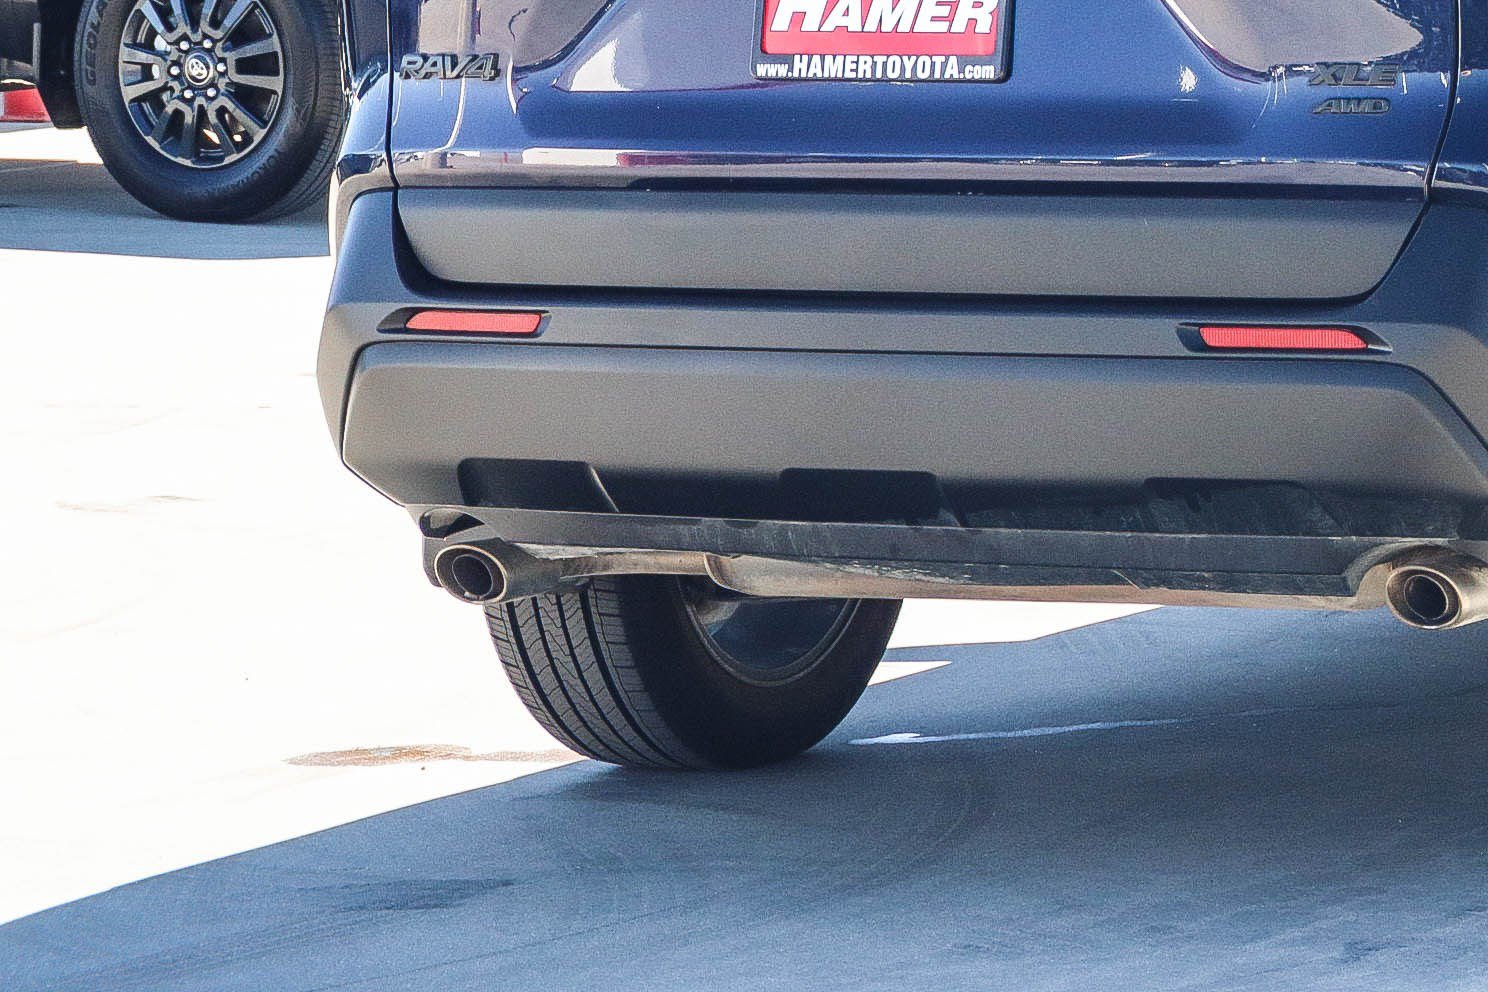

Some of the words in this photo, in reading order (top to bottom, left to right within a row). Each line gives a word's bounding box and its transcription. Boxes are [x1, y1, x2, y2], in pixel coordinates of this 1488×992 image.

[400, 52, 500, 82] RAV4
[756, 54, 995, 80] www.HAMERTOYOTA.com
[1309, 61, 1399, 87] XLE
[1312, 96, 1391, 115] AWD
